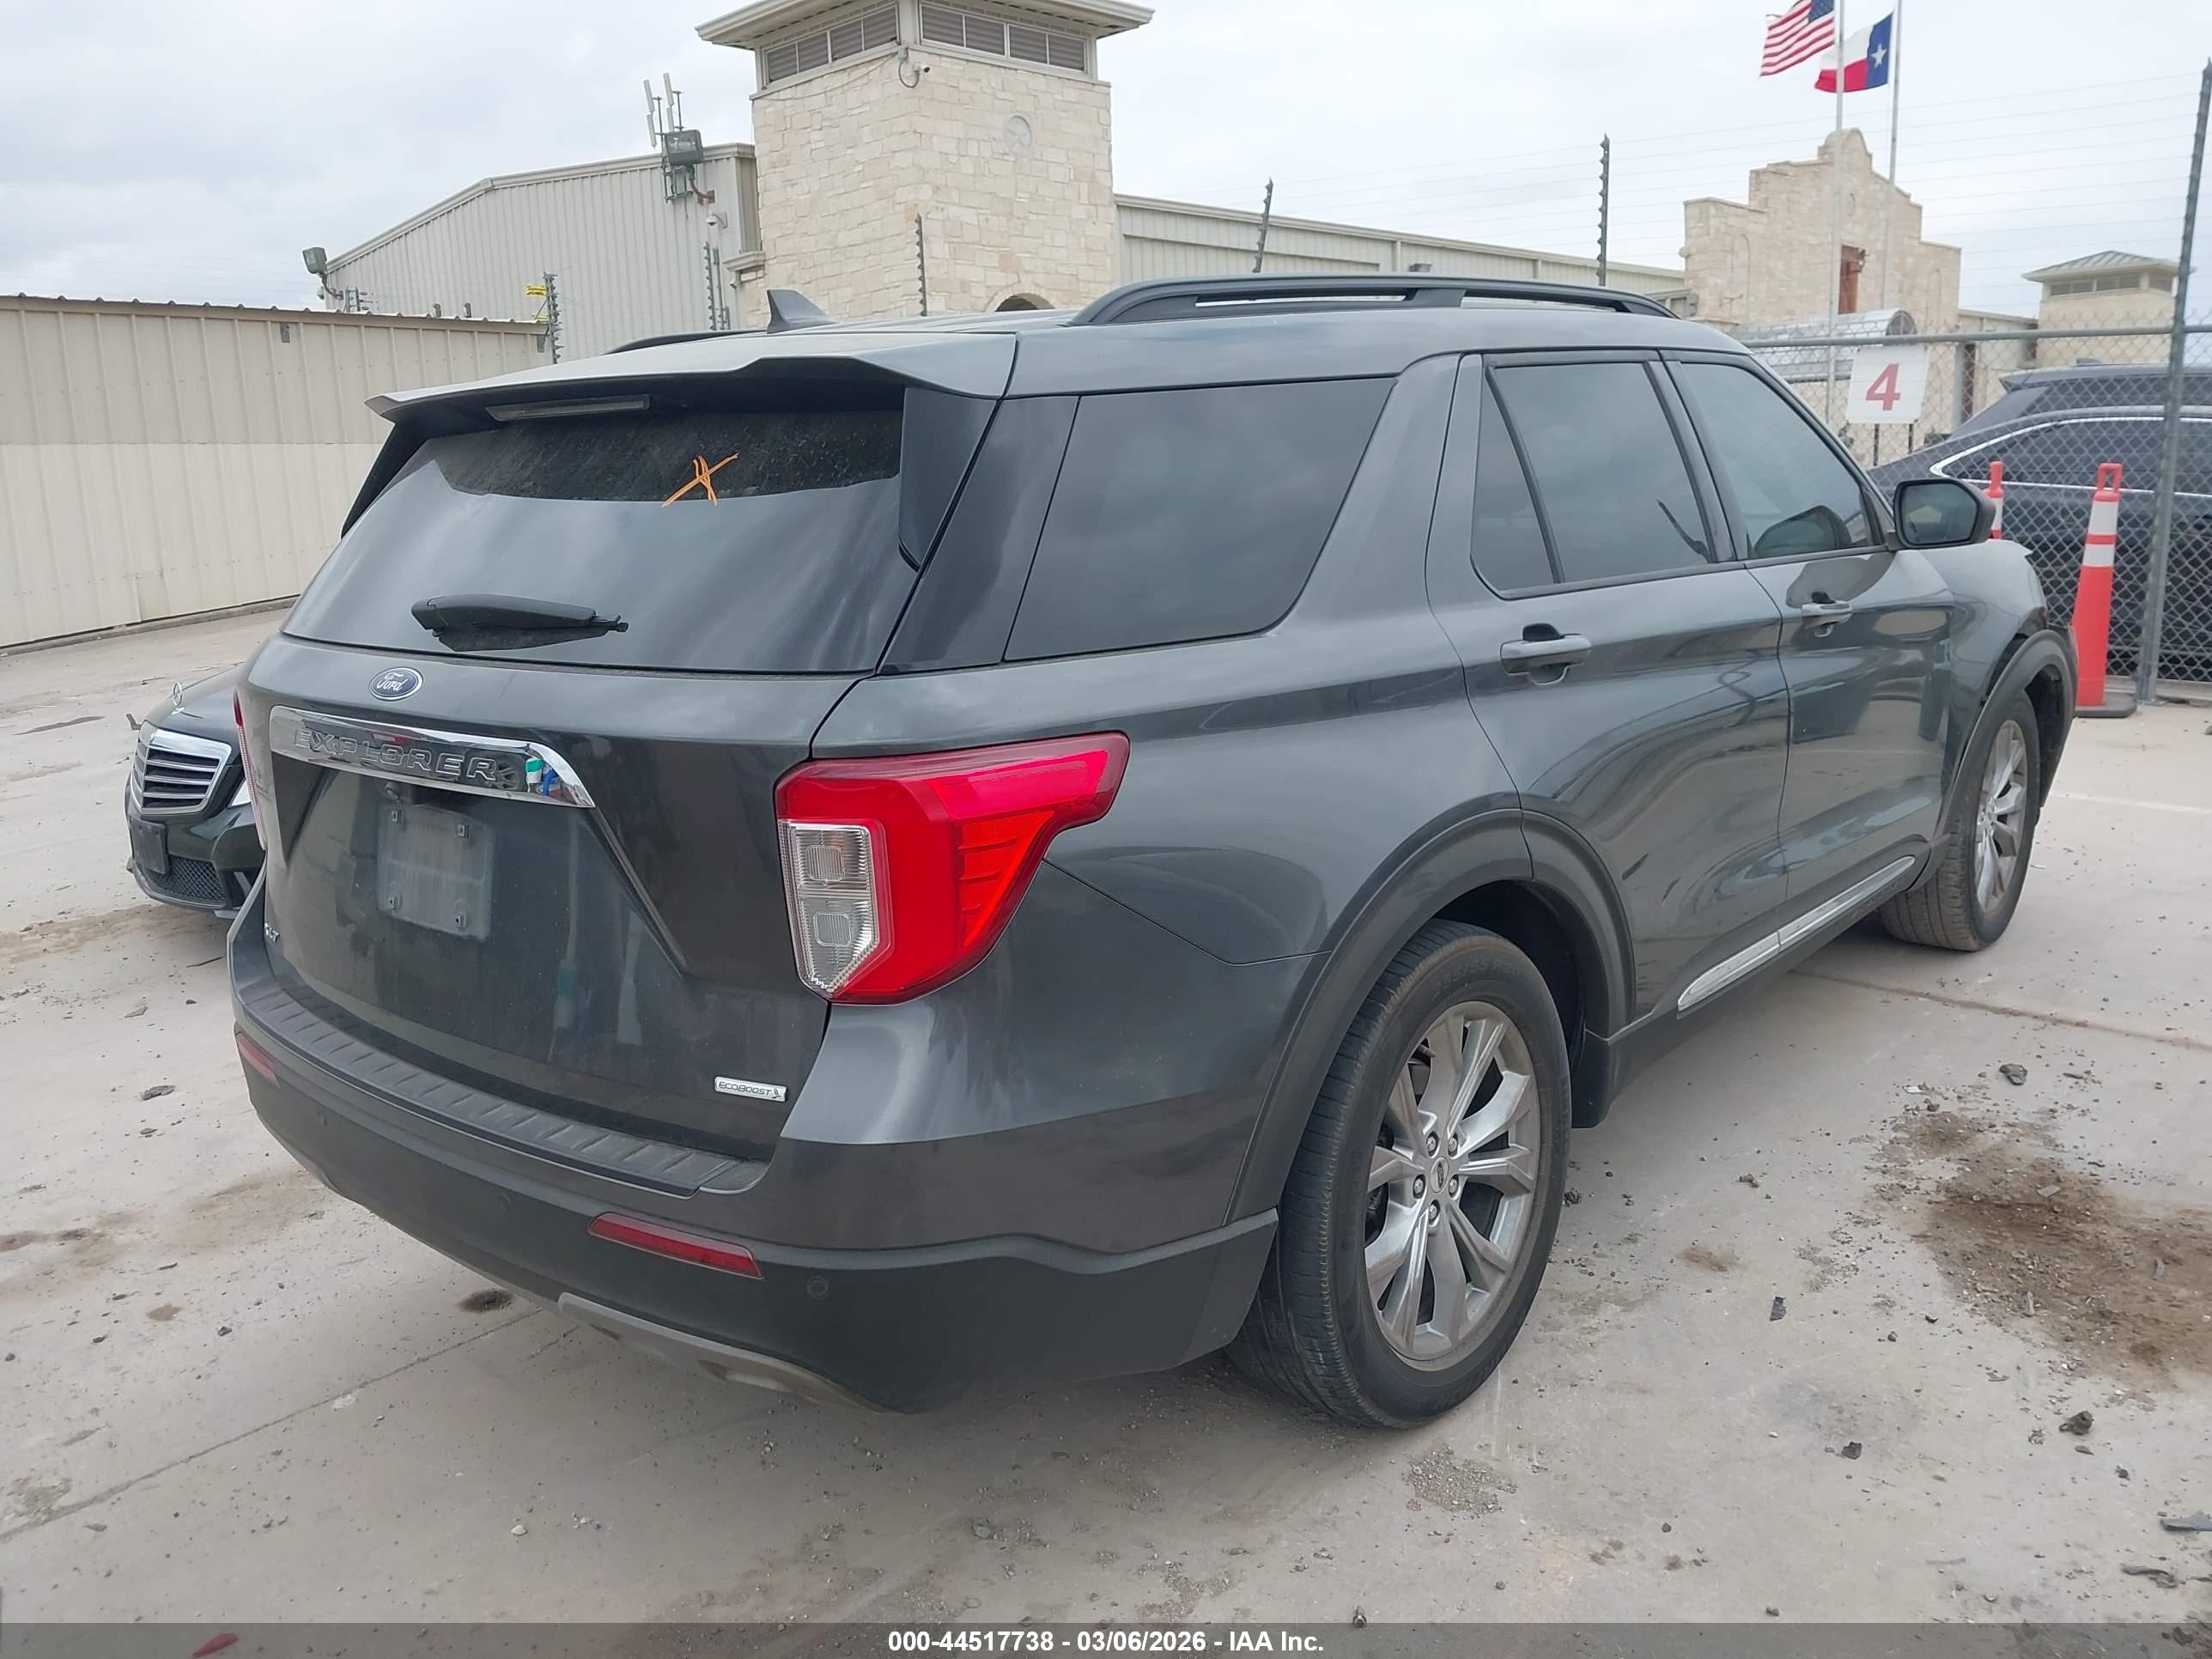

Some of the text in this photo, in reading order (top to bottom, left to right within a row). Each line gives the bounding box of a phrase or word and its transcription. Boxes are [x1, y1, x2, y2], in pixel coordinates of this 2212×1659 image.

[1865, 363, 1901, 411] 4
[376, 672, 409, 691] Ford
[295, 726, 497, 781] EXPLORER
[719, 1082, 772, 1096] ECOBOOST
